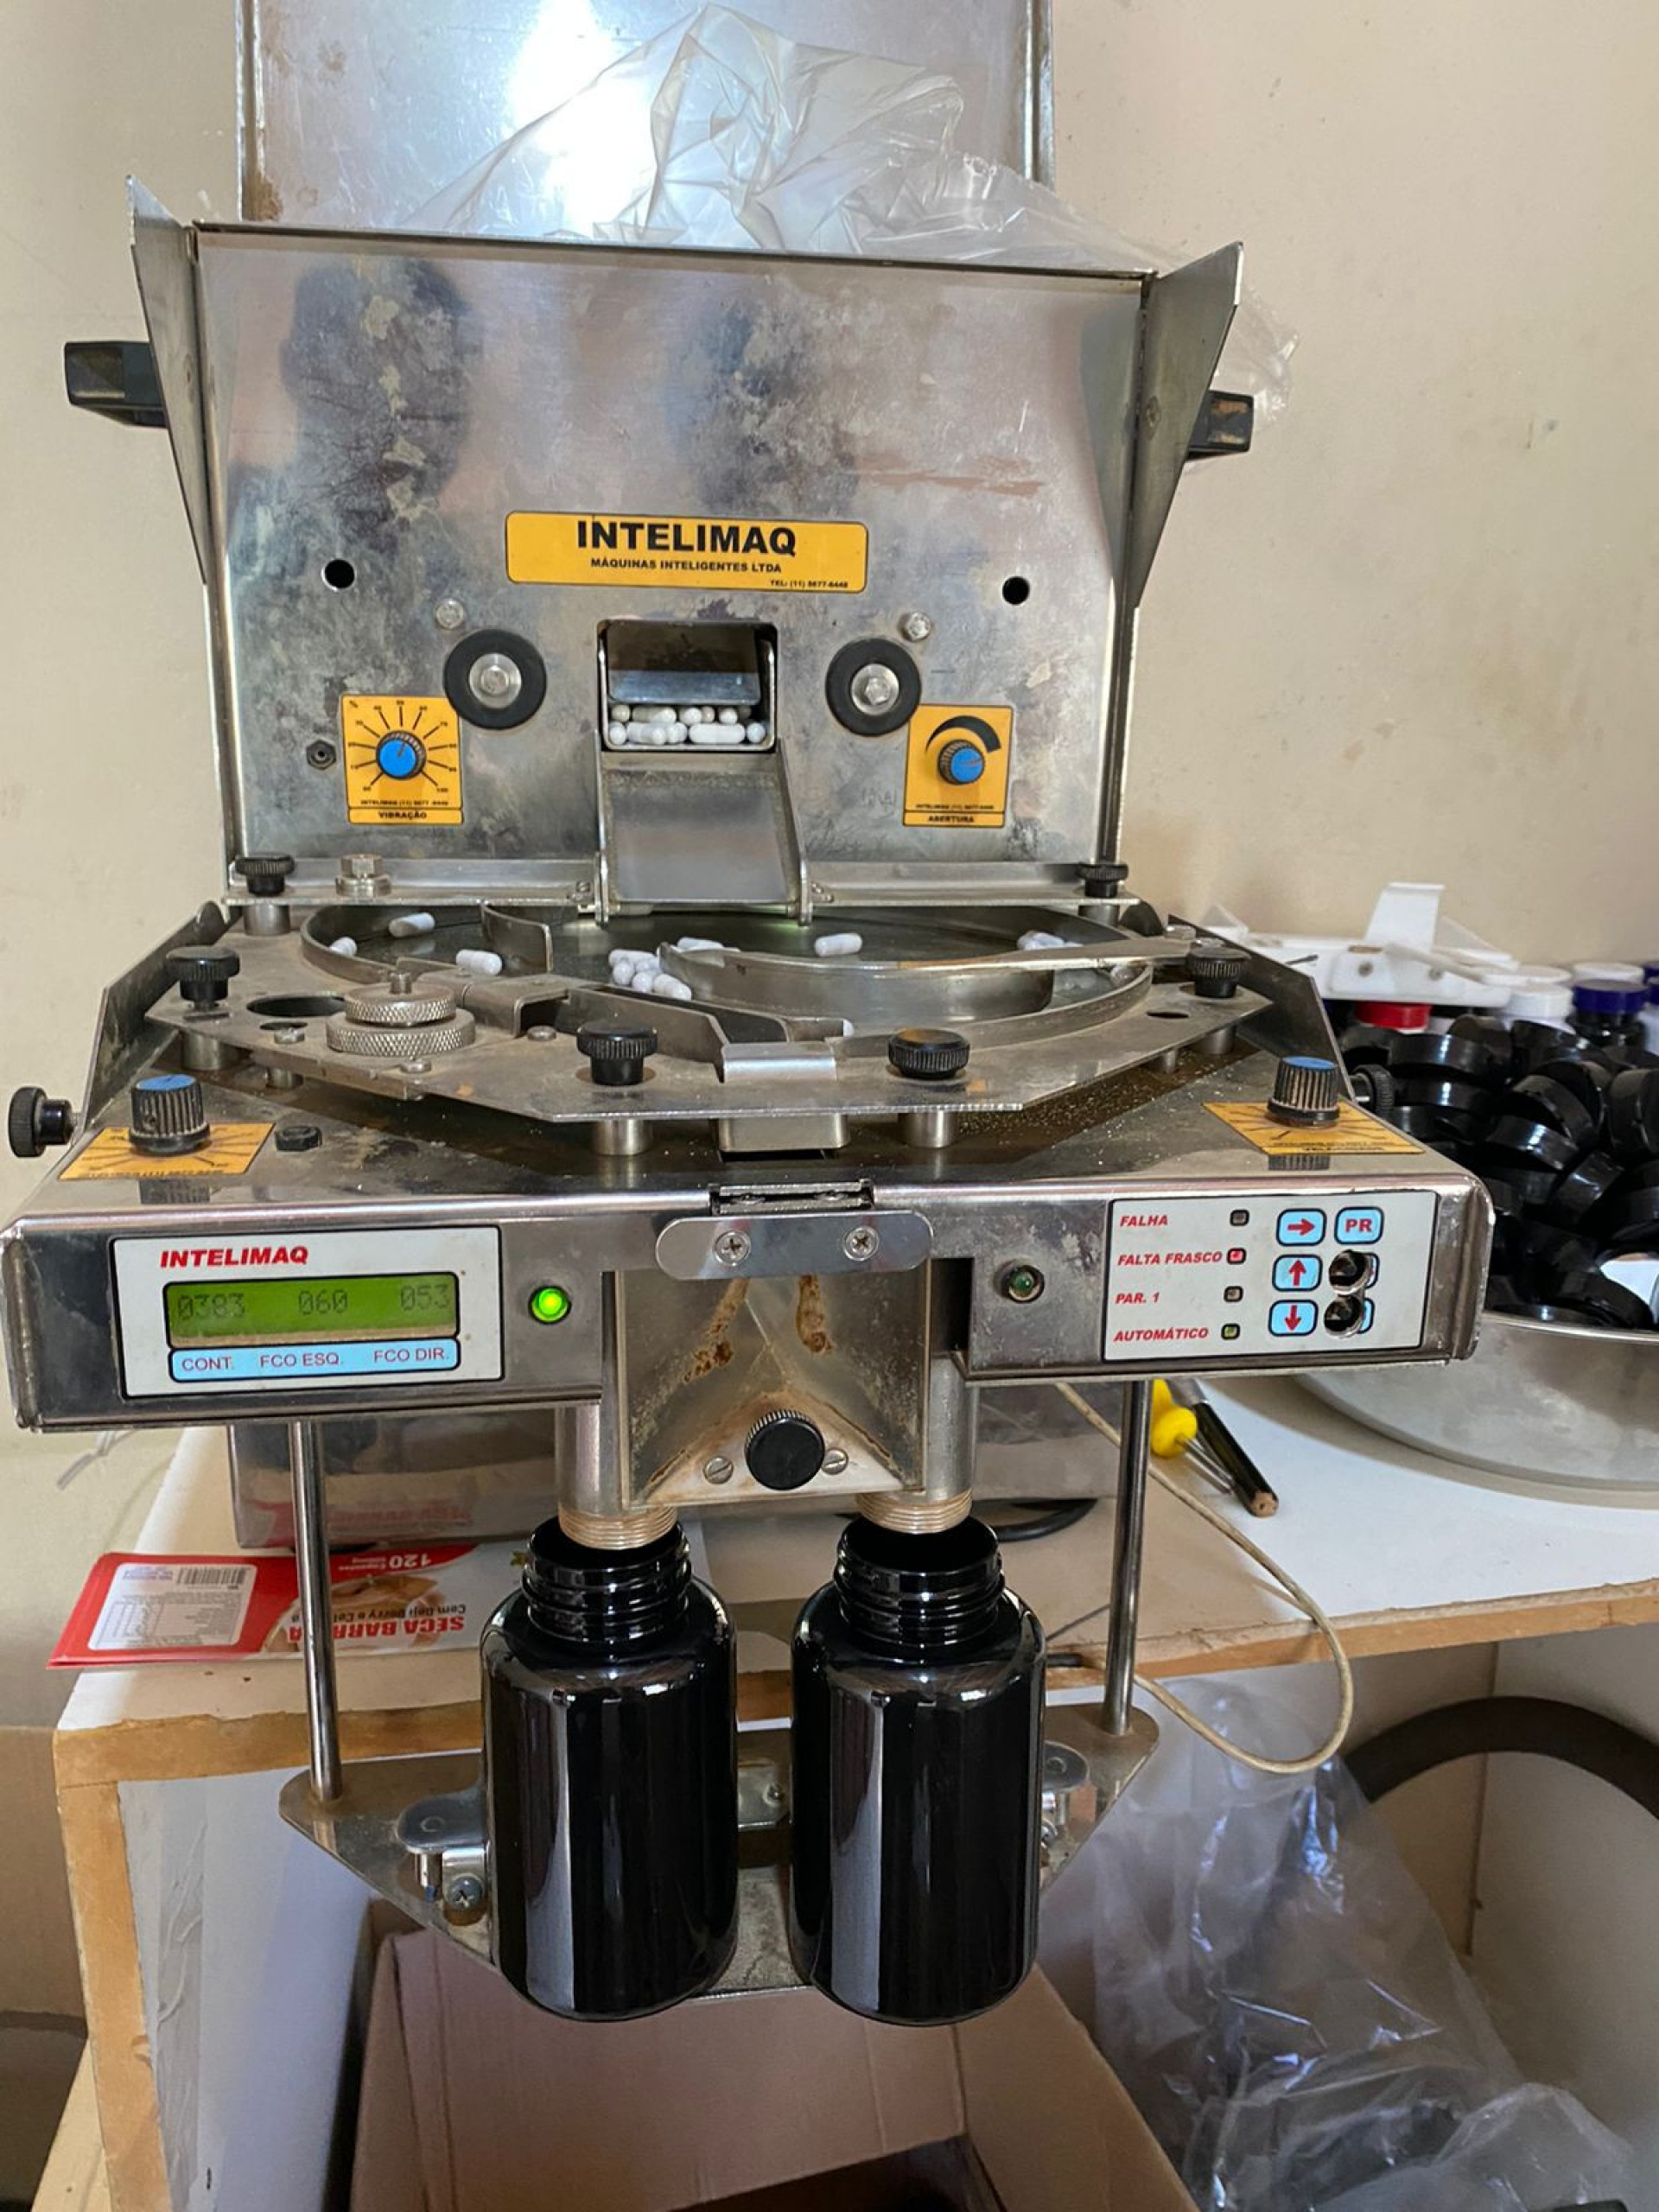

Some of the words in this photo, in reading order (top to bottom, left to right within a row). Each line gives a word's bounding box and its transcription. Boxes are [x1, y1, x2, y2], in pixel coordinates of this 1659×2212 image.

[577, 520, 797, 557] INTELIMAQ
[591, 557, 657, 570] MÁQUINAS
[660, 561, 748, 573] INTELIGENTES
[751, 564, 783, 574] LTDA
[378, 809, 428, 820] VIBRAÇÃO
[928, 815, 976, 823] ABERTURA
[1120, 1214, 1169, 1228] FALHA
[1344, 1217, 1373, 1234] PR
[160, 1245, 309, 1269] INTELIMAQ
[1117, 1253, 1161, 1267] FALTA
[1165, 1250, 1224, 1265] FRASCO
[298, 1288, 349, 1316] 060
[400, 1283, 451, 1312] 053
[1115, 1292, 1147, 1305] PAR.
[1152, 1292, 1160, 1304] 1
[1113, 1326, 1209, 1343] AUTOMÁTICO
[260, 1353, 297, 1369] FCO
[373, 1348, 410, 1363] FCO
[415, 1346, 450, 1362] DIR.
[389, 1553, 431, 1569] 120
[404, 1615, 465, 1636] SECA
